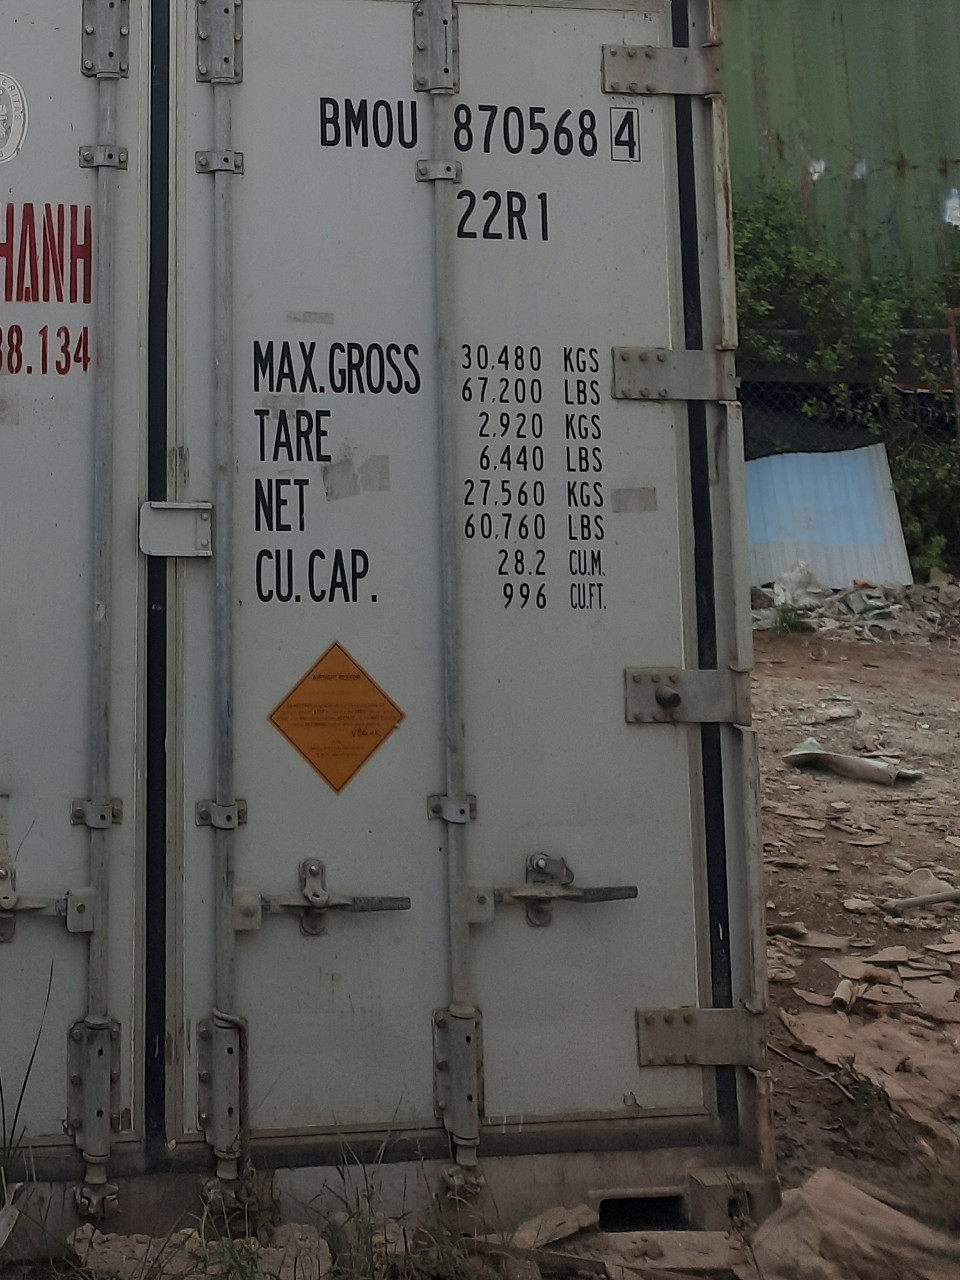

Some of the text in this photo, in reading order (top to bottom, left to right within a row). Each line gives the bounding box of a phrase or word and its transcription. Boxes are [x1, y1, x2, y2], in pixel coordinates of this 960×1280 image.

[319, 97, 637, 160] BMOU 870568 4
[456, 189, 549, 241] 22R1
[253, 340, 599, 394] MAX.GROSS 30,480 KGS
[461, 377, 600, 405] 67,200 LBS
[254, 409, 601, 462] TARE 2,920 KGS
[480, 445, 602, 472] 6,440 LBS
[254, 478, 604, 532] NET 27,560 KGS
[464, 513, 605, 540] 60,760 LBS
[255, 549, 606, 602] CU.CAP. 28.2 CU.M.
[503, 582, 547, 609] 996
